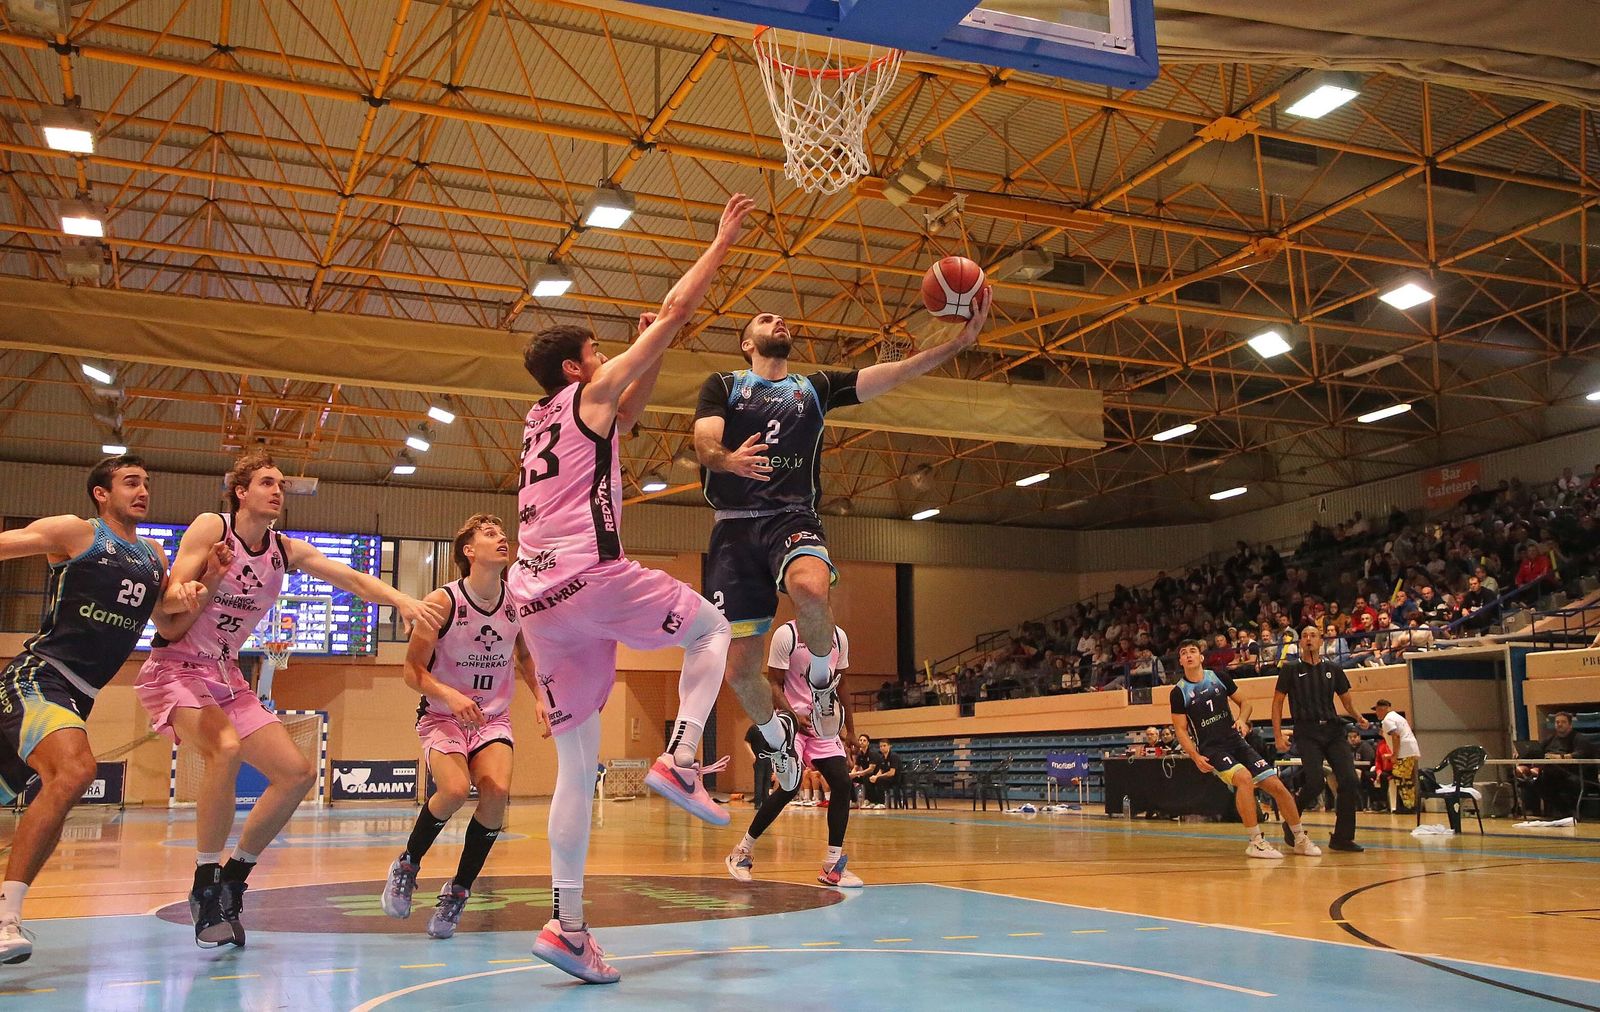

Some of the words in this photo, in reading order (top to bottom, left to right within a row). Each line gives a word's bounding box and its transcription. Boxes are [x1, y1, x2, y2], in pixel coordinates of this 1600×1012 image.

[765, 420, 780, 444] 2
[1442, 467, 1461, 480] Bar
[117, 579, 147, 607] 29
[520, 601, 547, 617] CAJA
[713, 590, 725, 616] 2
[216, 613, 243, 632] 25
[473, 674, 493, 690] 10
[1205, 699, 1214, 712] 7
[1223, 756, 1232, 765] 7
